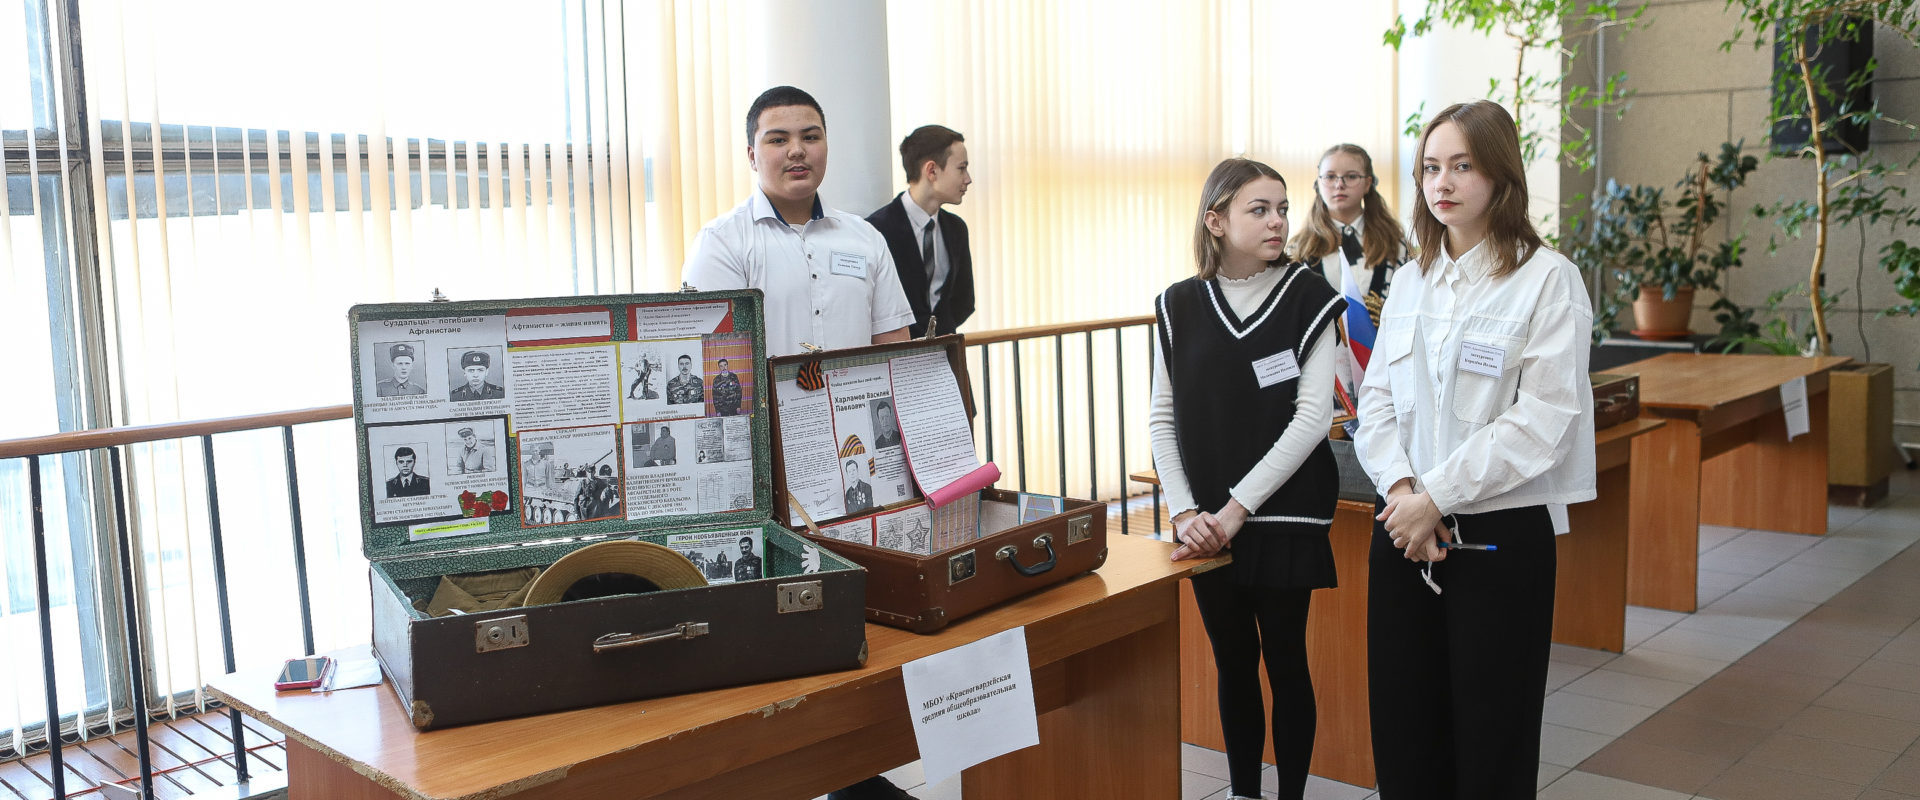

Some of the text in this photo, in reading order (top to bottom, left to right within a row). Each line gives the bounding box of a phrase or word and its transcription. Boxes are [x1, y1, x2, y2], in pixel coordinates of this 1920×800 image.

[384, 319, 430, 328] Суздальцы
[438, 317, 476, 326] погибшие
[512, 322, 554, 330] Афганистан
[408, 327, 462, 336] Афганистане
[834, 395, 865, 404] Харламов
[866, 389, 890, 399] Василий
[836, 402, 866, 412] Павлович
[922, 673, 1012, 710] МБОУ «Красногвардейская
[922, 683, 1016, 724] средняя общеобразовательная
[956, 708, 981, 721] школа»
